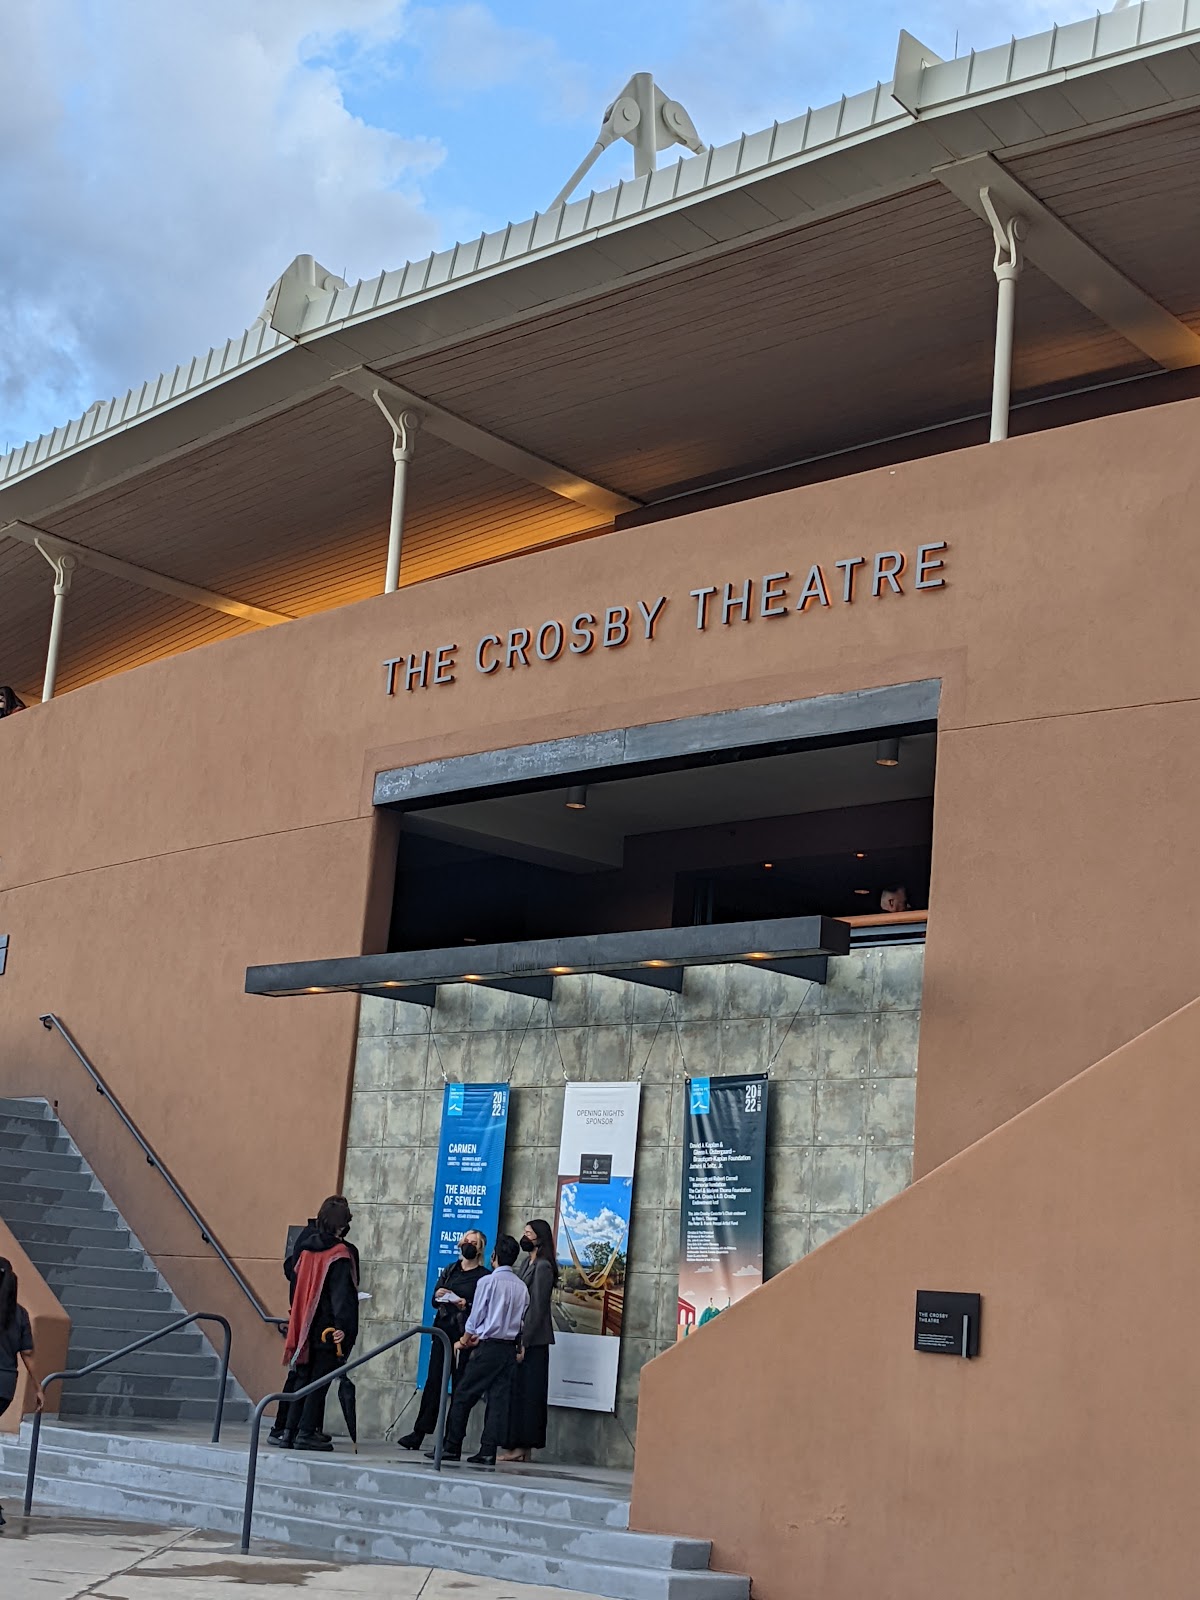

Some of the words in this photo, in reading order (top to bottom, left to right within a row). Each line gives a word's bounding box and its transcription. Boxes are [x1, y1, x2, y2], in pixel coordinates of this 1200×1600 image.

[382, 644, 457, 696] THE
[475, 596, 667, 674] CROSBY
[690, 541, 948, 630] THEATRE
[493, 1091, 502, 1104] 20
[745, 1084, 757, 1099] 20
[492, 1104, 502, 1116] 22
[744, 1098, 757, 1113] 22
[576, 1109, 602, 1117] OPENING
[602, 1109, 625, 1117] NIGHTS
[448, 1143, 477, 1154] CARMEN
[445, 1184, 459, 1194] THE
[459, 1185, 487, 1196] BARBER
[443, 1195, 453, 1206] OF
[454, 1196, 482, 1207] SEVILLE
